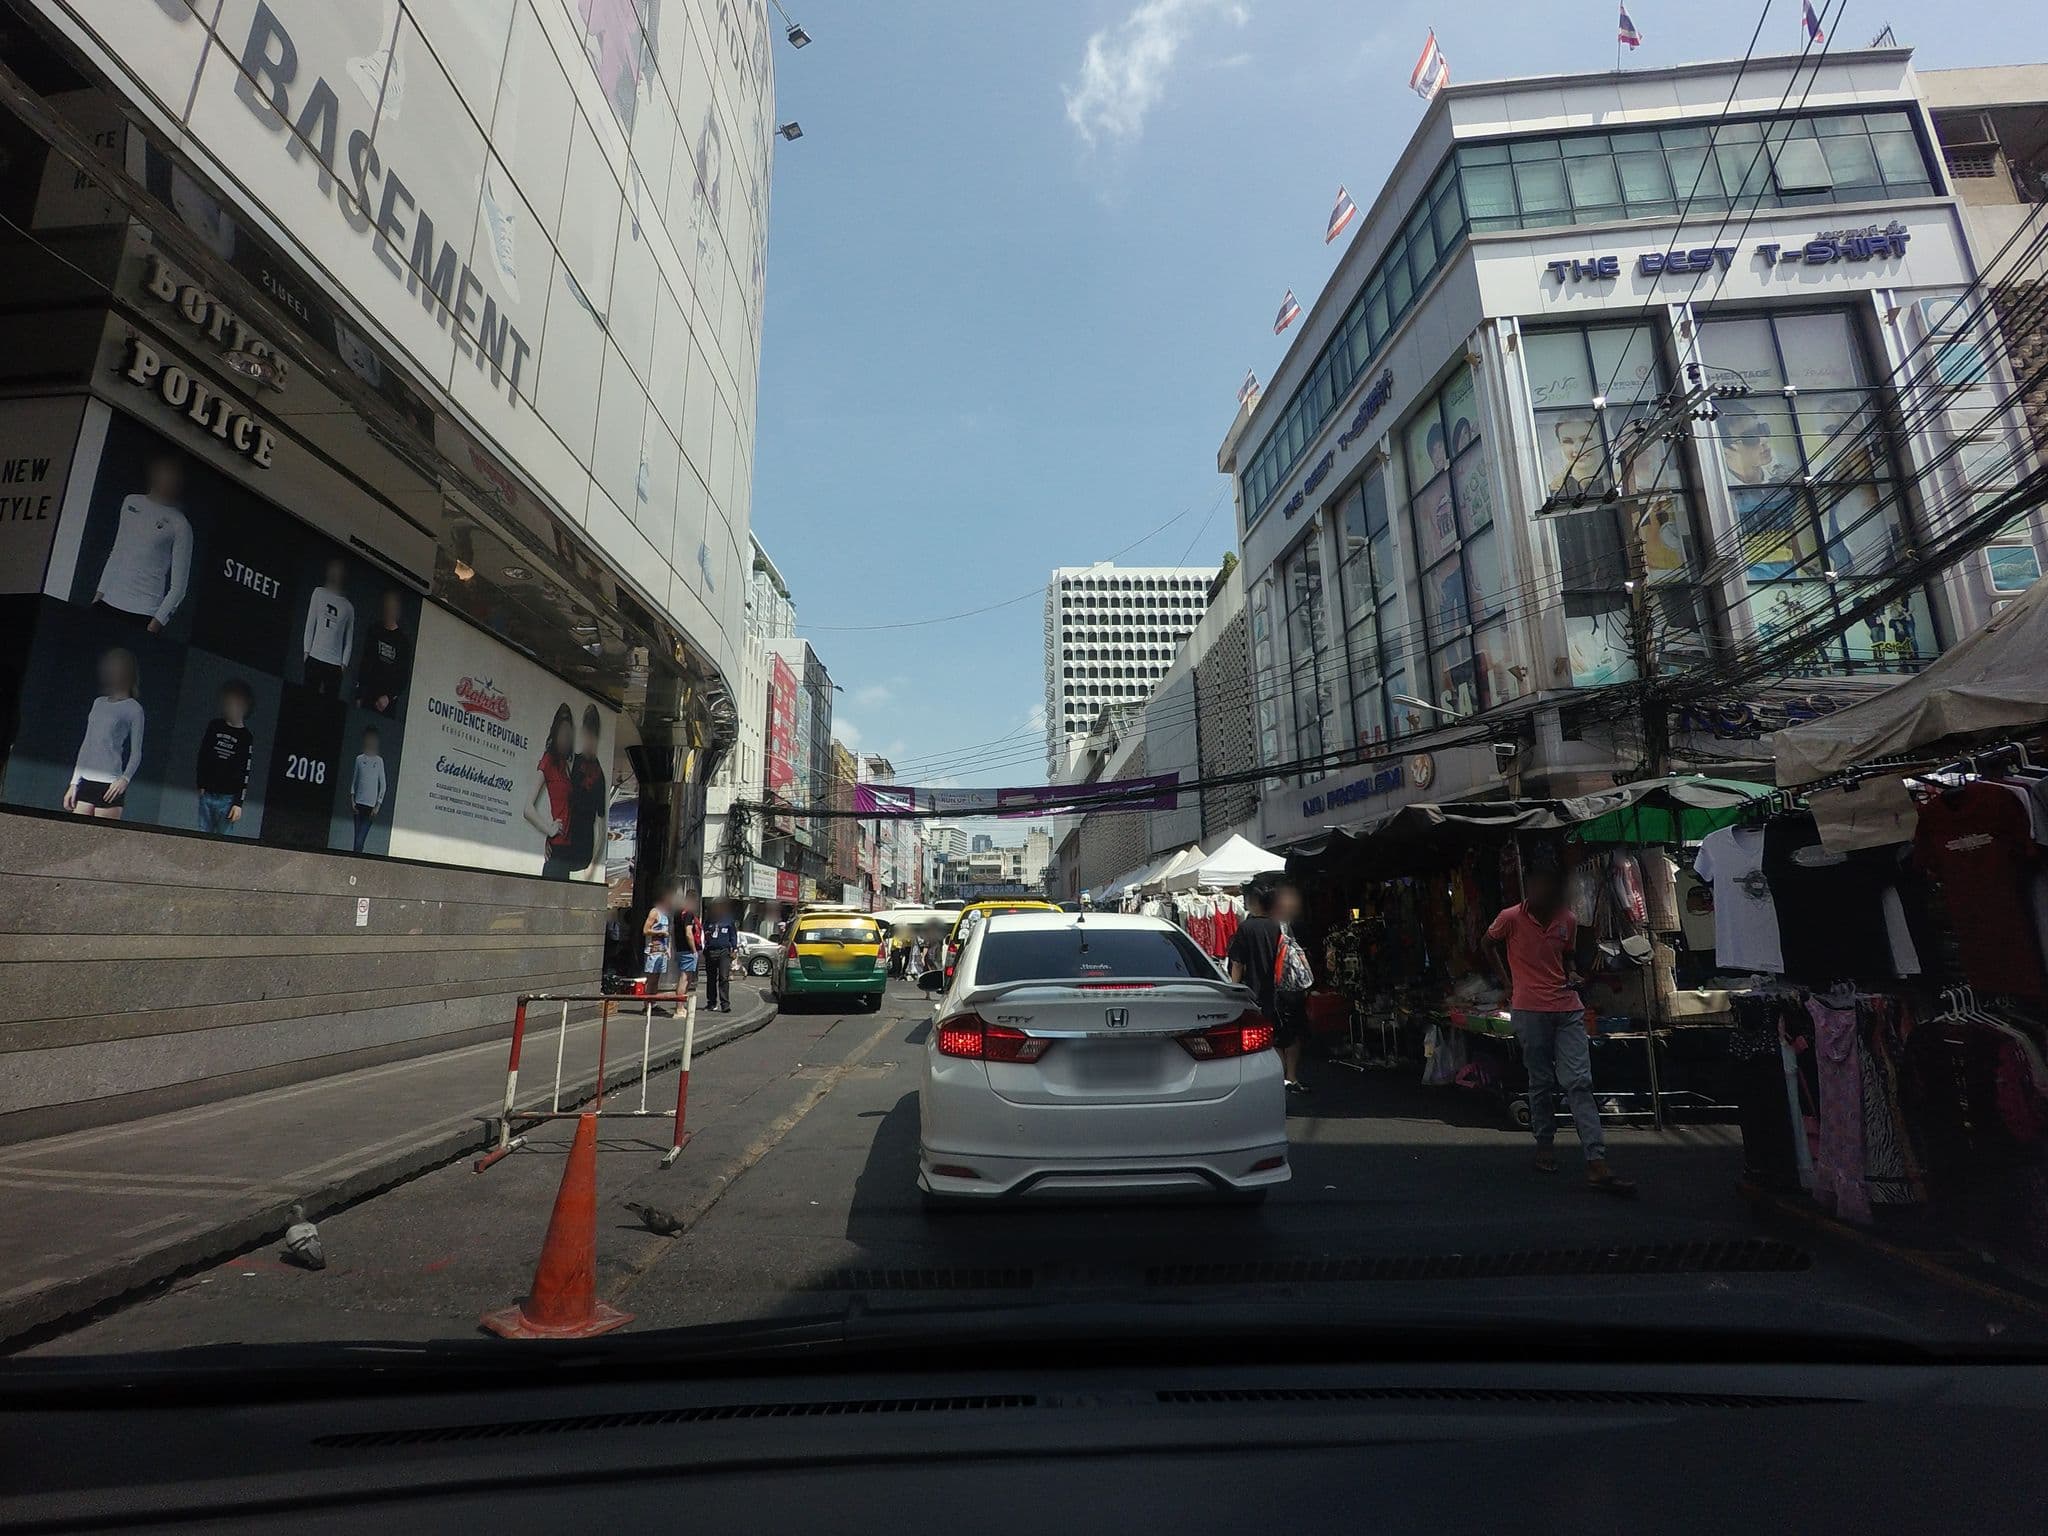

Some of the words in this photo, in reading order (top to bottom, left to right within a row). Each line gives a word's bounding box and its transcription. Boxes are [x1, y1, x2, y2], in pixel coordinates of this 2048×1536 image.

[234, 0, 530, 408] BASEMENT
[1548, 255, 1620, 283] THE
[1639, 247, 1736, 276] BEST
[1758, 234, 1911, 267] T-SHIRT
[127, 338, 277, 468] POLICE
[3, 458, 50, 483] NEW
[1283, 490, 1303, 520] THE
[223, 558, 281, 600] STREET
[428, 698, 485, 733] CONFIDENCE
[487, 722, 529, 751] REPUTABLE
[285, 754, 326, 785] 2018
[1303, 795, 1324, 817] NO
